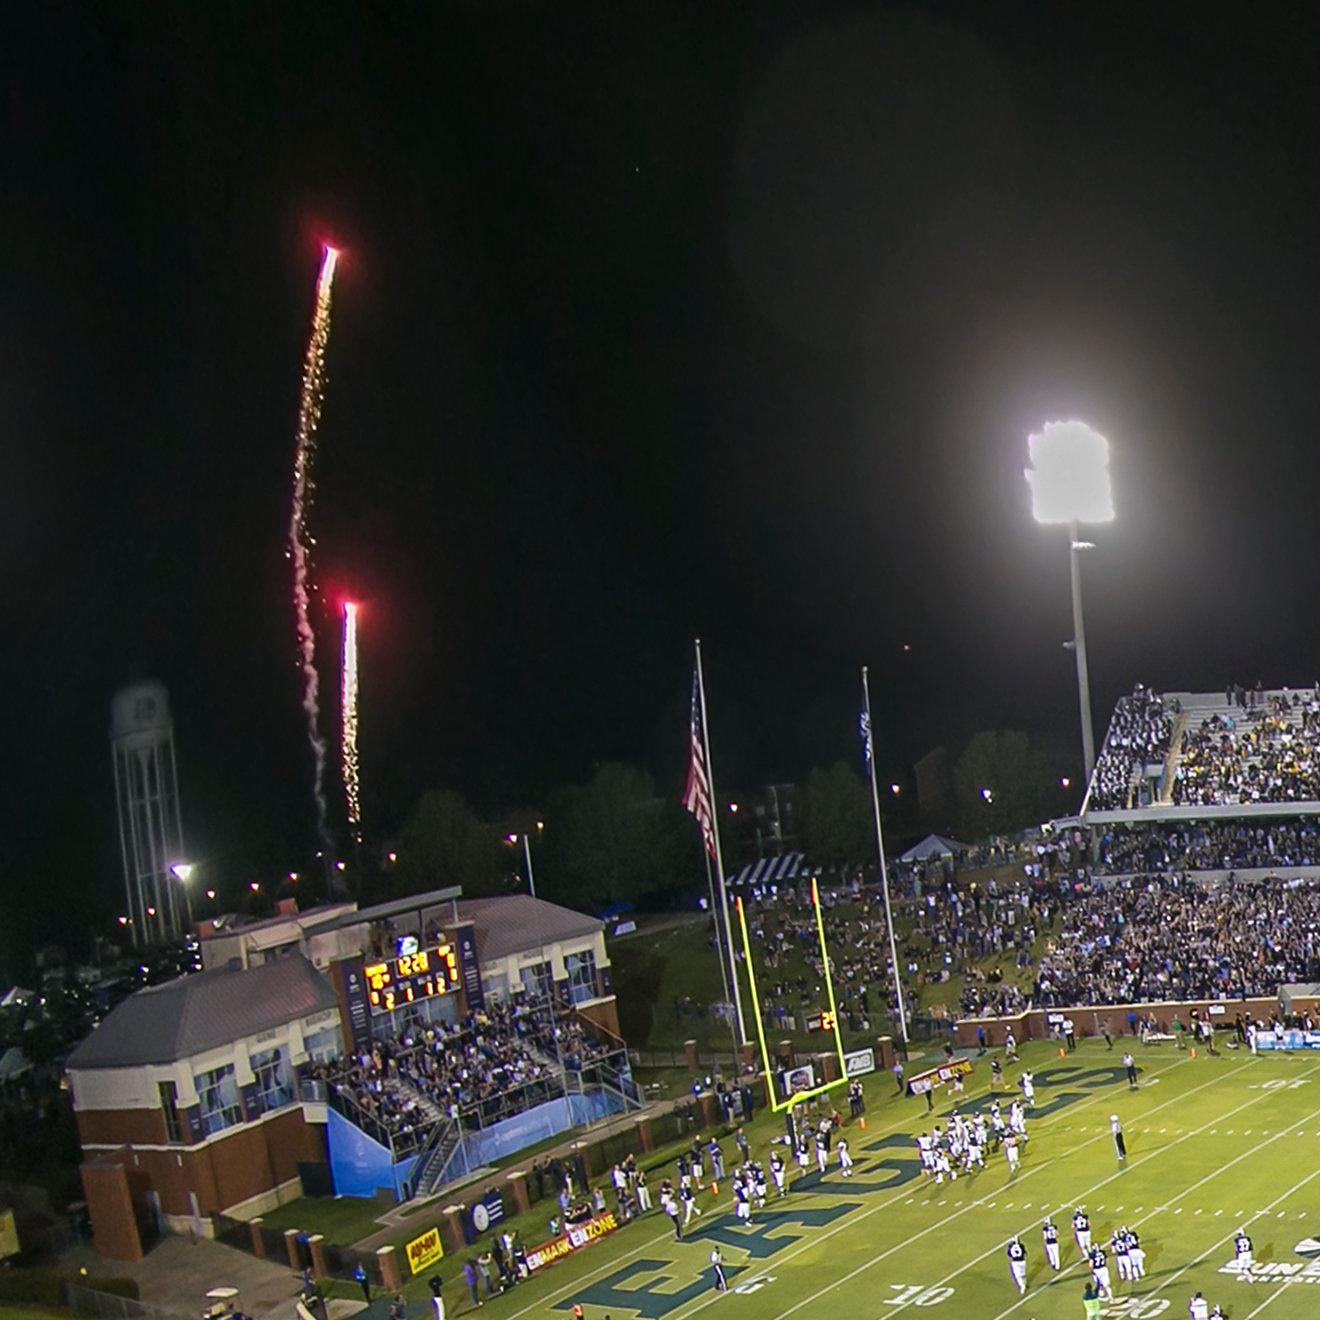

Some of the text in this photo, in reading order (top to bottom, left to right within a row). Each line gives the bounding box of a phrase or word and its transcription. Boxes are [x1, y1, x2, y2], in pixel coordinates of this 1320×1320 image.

[548, 1066, 1143, 1319] EAGES
[526, 1214, 618, 1271] ENMARK ENZONE
[883, 1284, 956, 1308] 10
